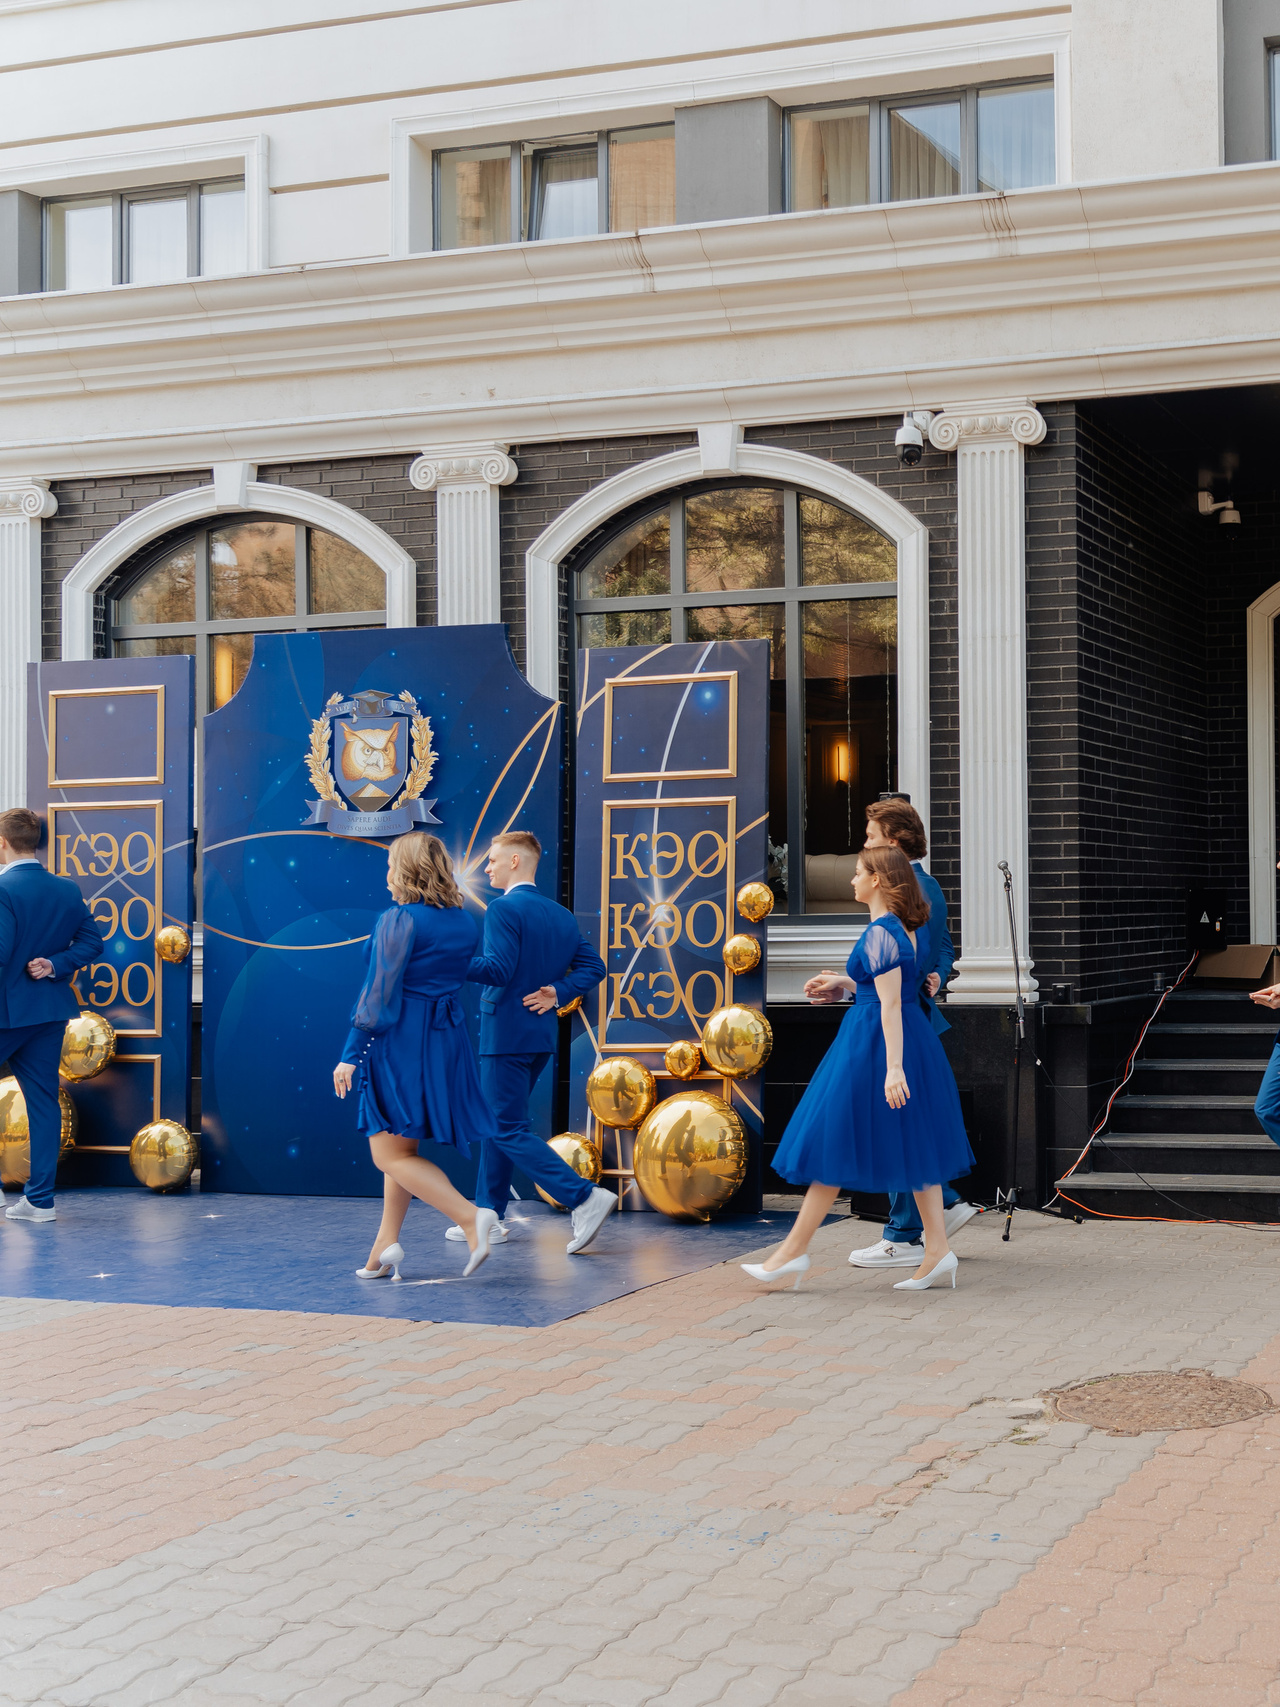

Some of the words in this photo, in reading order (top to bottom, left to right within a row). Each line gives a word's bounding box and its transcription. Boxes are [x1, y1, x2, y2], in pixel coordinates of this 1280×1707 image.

[347, 815, 371, 823] SAPERE
[373, 815, 392, 823] AUDE
[354, 825, 373, 833] QUAM
[56, 831, 156, 877] КЭО
[610, 830, 727, 879] КЭО
[82, 897, 156, 941] ЭО
[608, 900, 725, 949] КЭО
[608, 970, 724, 1019] КЭО
